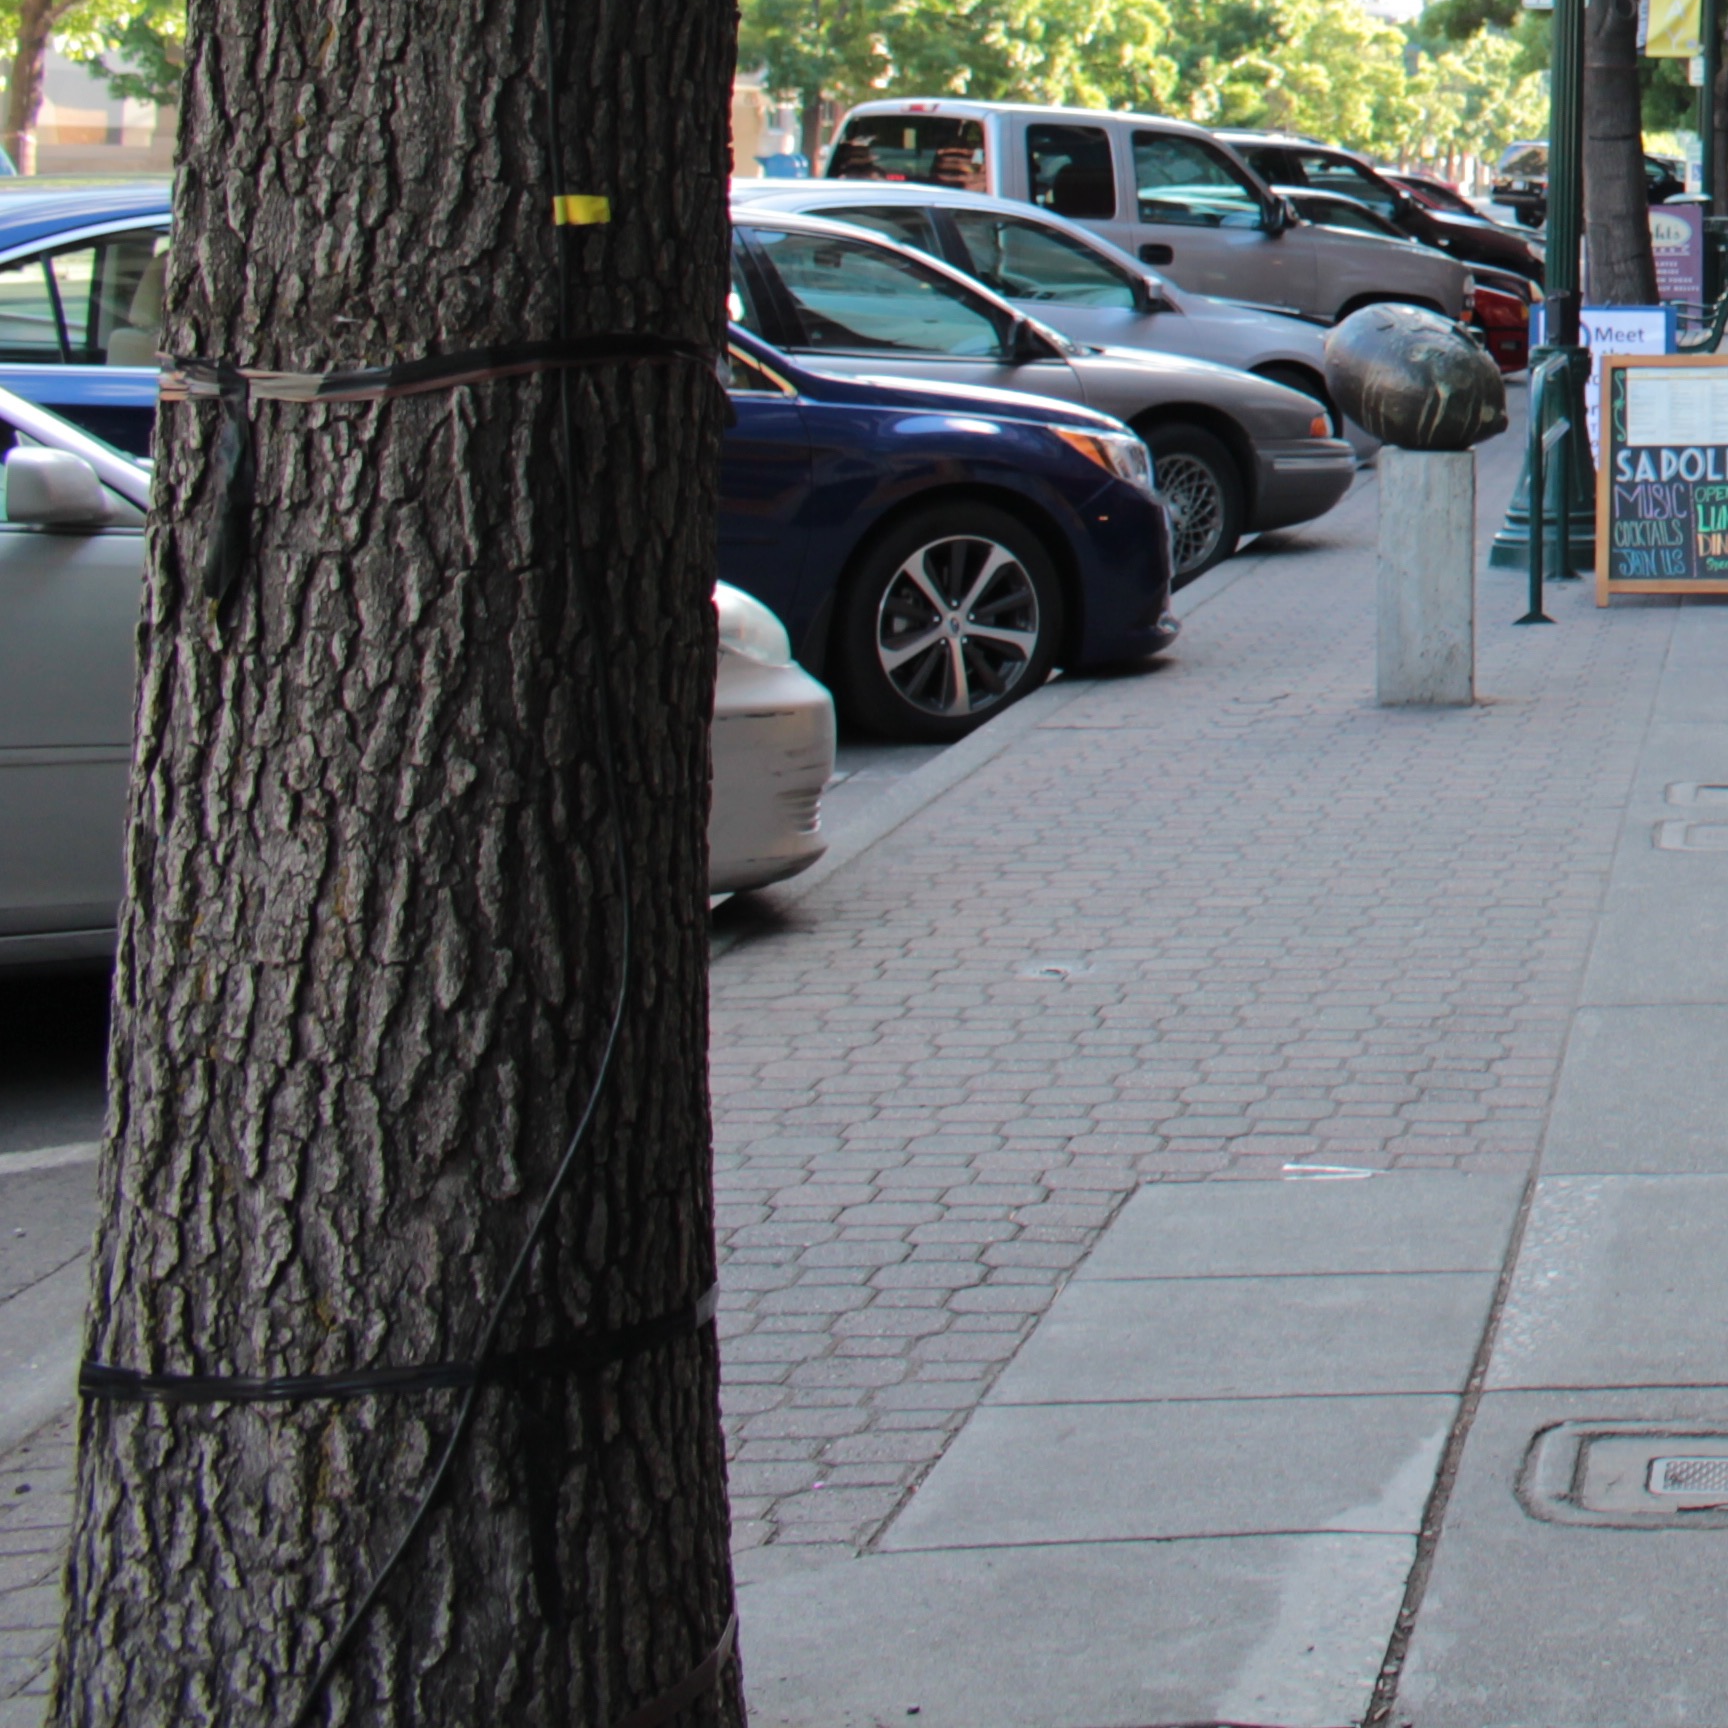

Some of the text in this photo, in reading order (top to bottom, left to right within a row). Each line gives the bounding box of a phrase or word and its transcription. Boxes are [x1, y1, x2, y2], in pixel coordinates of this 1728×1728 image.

[1595, 327, 1644, 344] Meet
[1614, 482, 1687, 519] MUSIC
[1614, 519, 1683, 547] COCKTAILS
[1613, 548, 1686, 576] JOIN US
